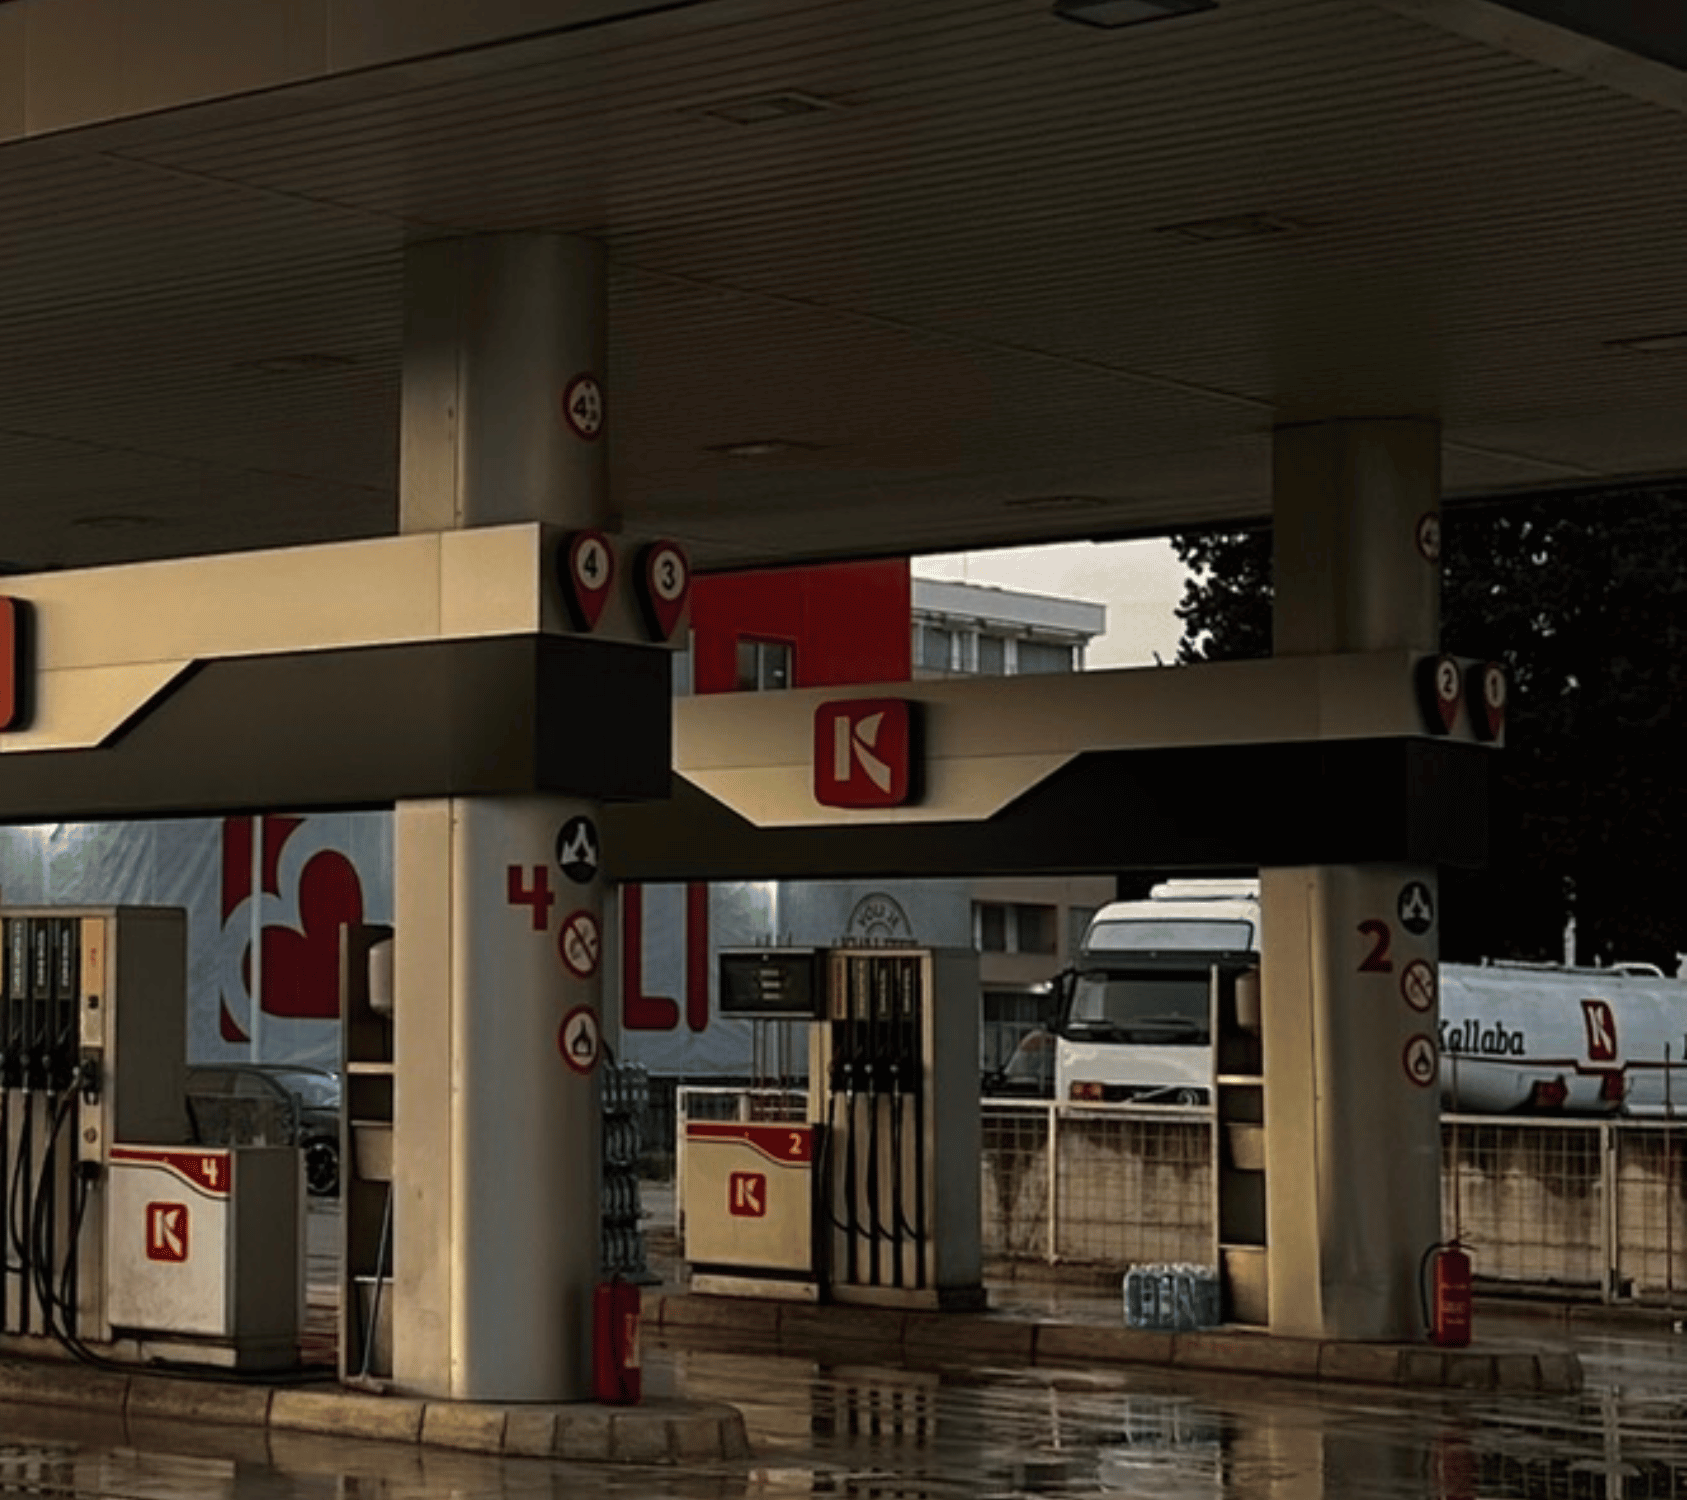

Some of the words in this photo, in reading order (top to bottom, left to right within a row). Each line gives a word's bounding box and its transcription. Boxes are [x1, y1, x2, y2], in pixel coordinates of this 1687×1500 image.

[583, 548, 599, 579] 4
[660, 559, 676, 591] 3
[1442, 666, 1454, 694] 2
[507, 864, 555, 931] 4
[1356, 918, 1393, 973] 2
[788, 1132, 803, 1155] 2
[201, 1157, 218, 1186] 4
